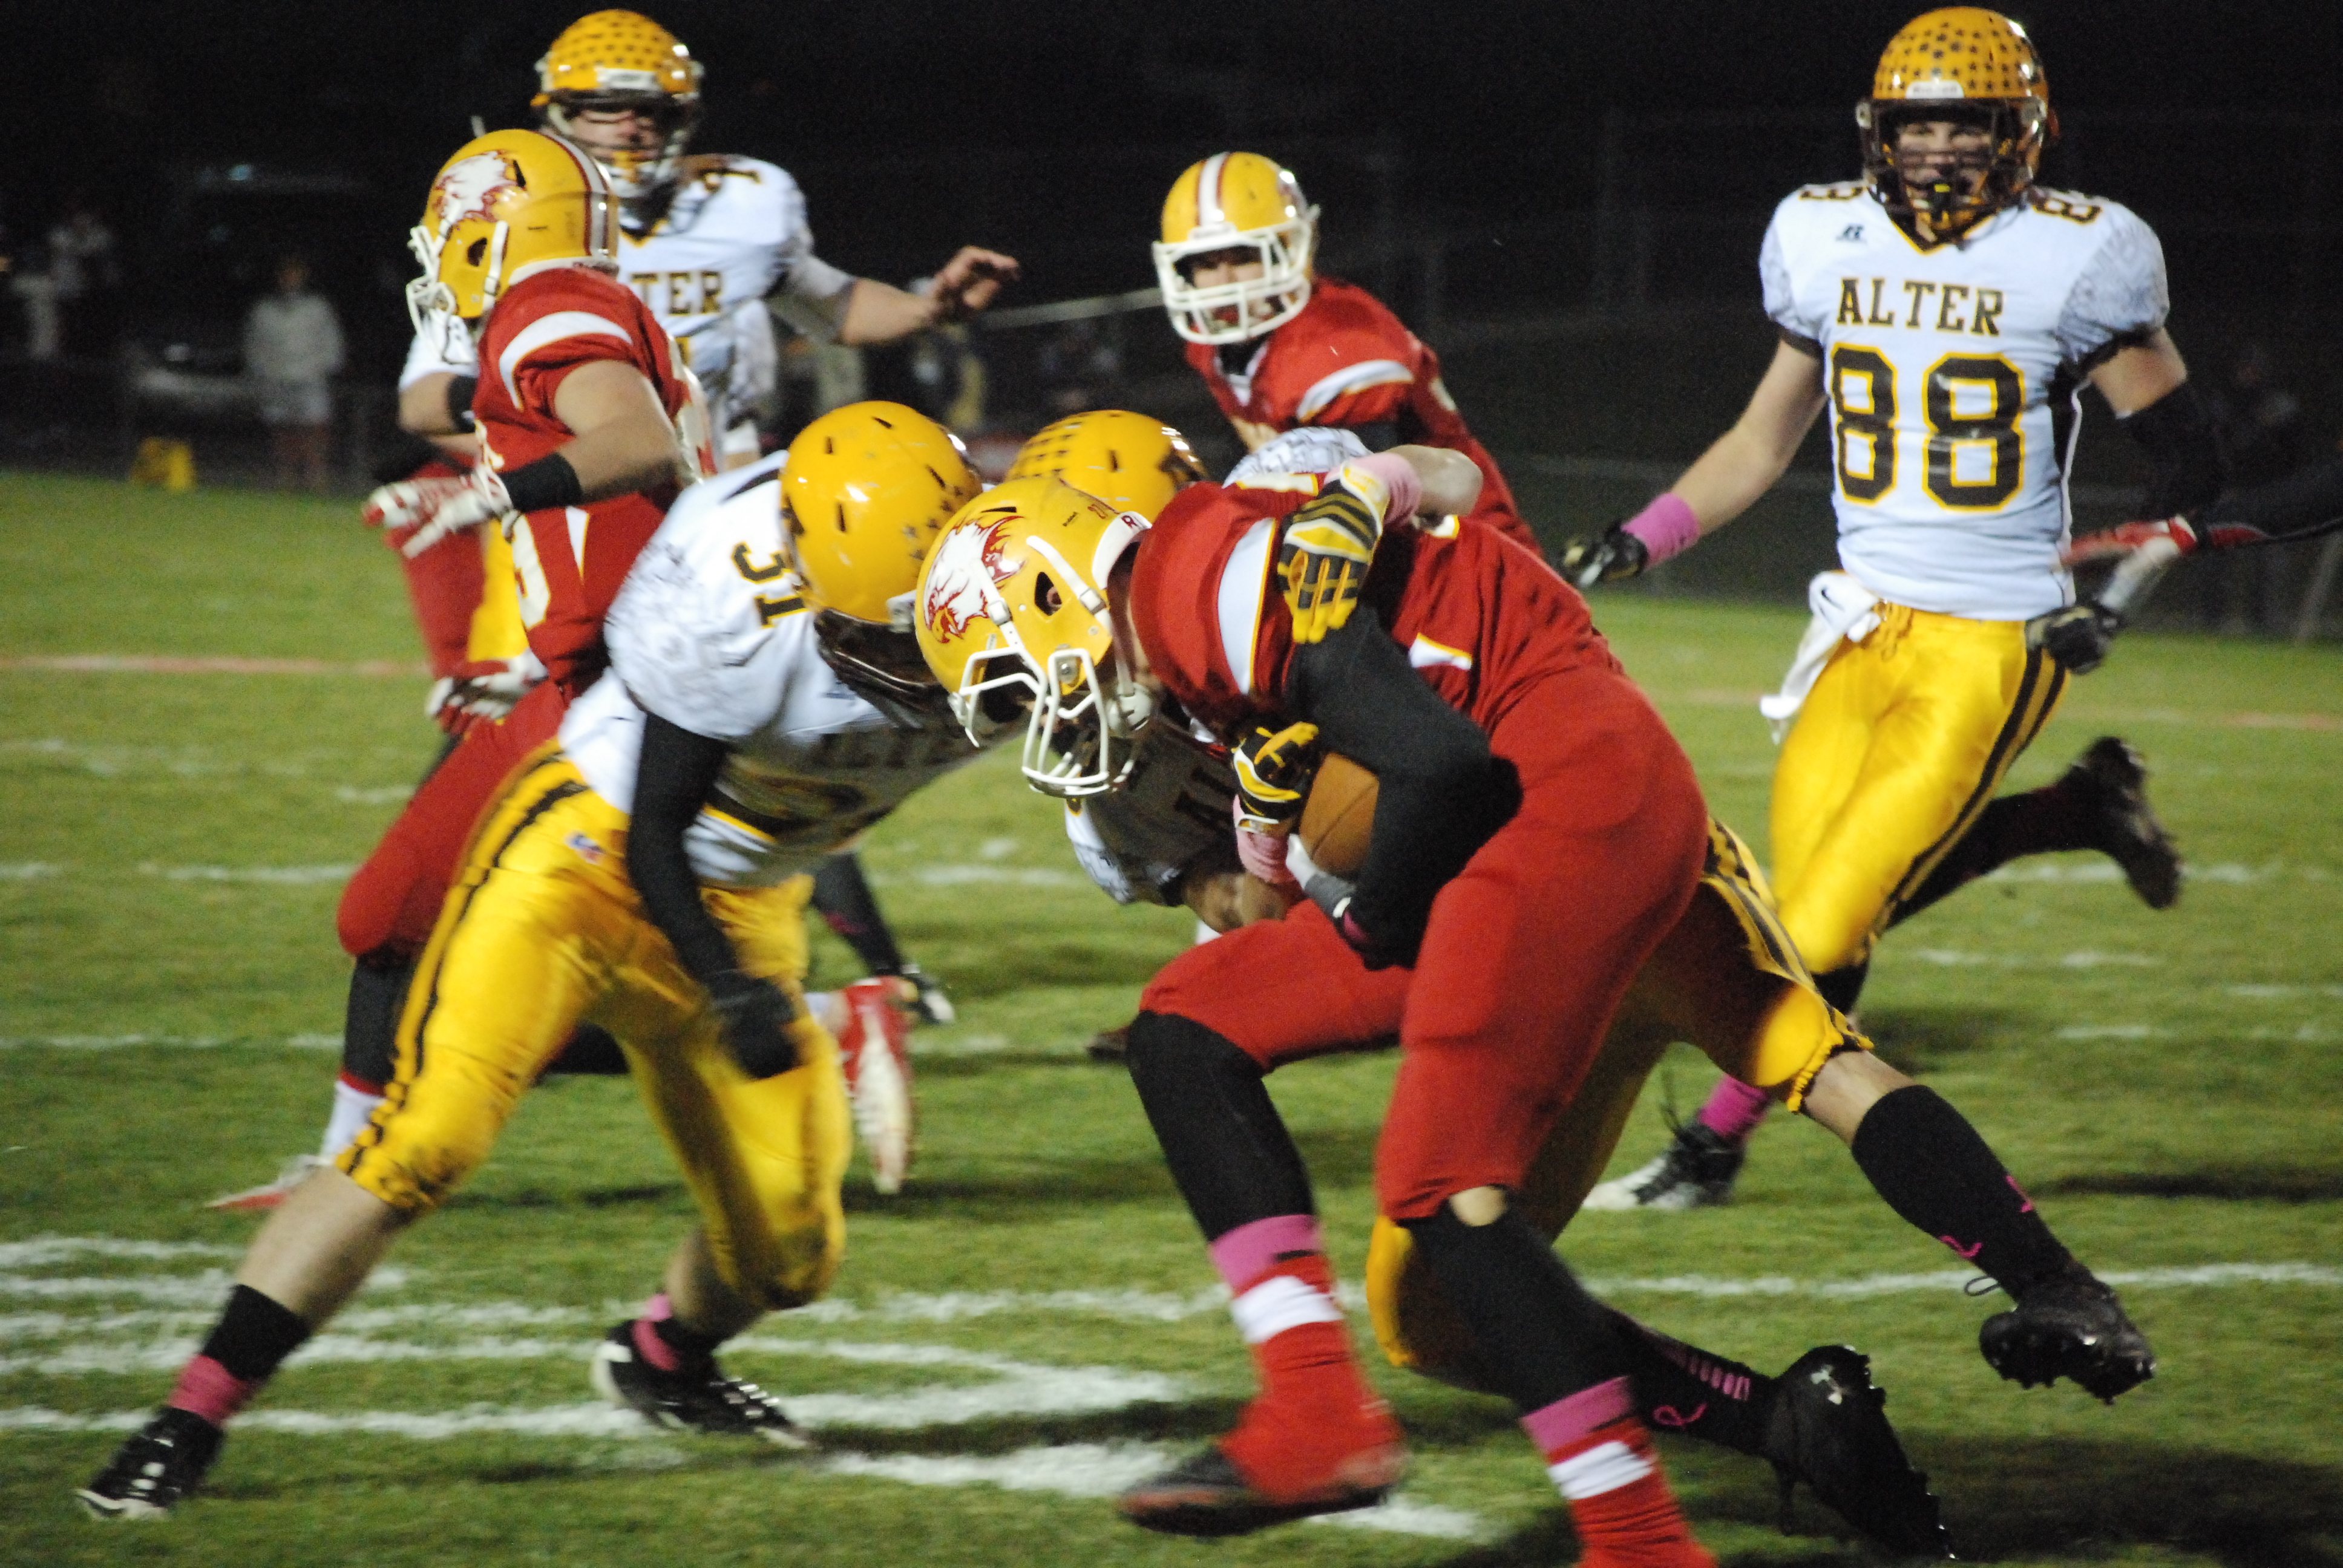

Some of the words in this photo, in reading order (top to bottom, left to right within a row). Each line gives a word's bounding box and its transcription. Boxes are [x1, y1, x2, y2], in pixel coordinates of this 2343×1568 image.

[632, 272, 721, 316] TER
[1836, 277, 2005, 337] ALTER
[1830, 342, 2025, 513] 88
[731, 541, 809, 629] 31
